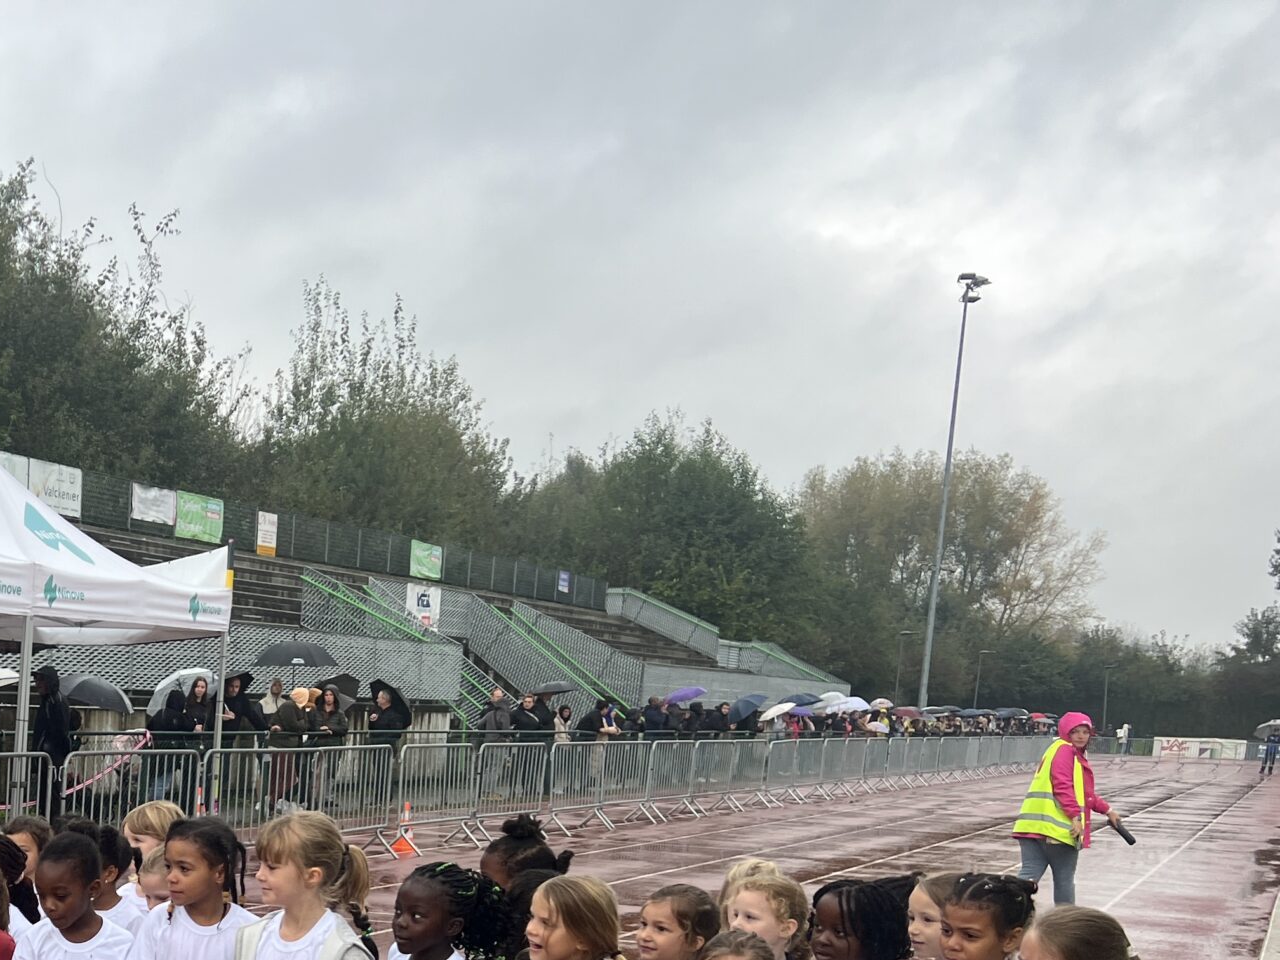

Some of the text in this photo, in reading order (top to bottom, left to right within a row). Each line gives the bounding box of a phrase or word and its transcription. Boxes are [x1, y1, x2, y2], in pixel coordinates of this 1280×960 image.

[43, 485, 80, 502] Valckenier
[57, 587, 85, 601] Ninove
[200, 600, 221, 615] Ninove
